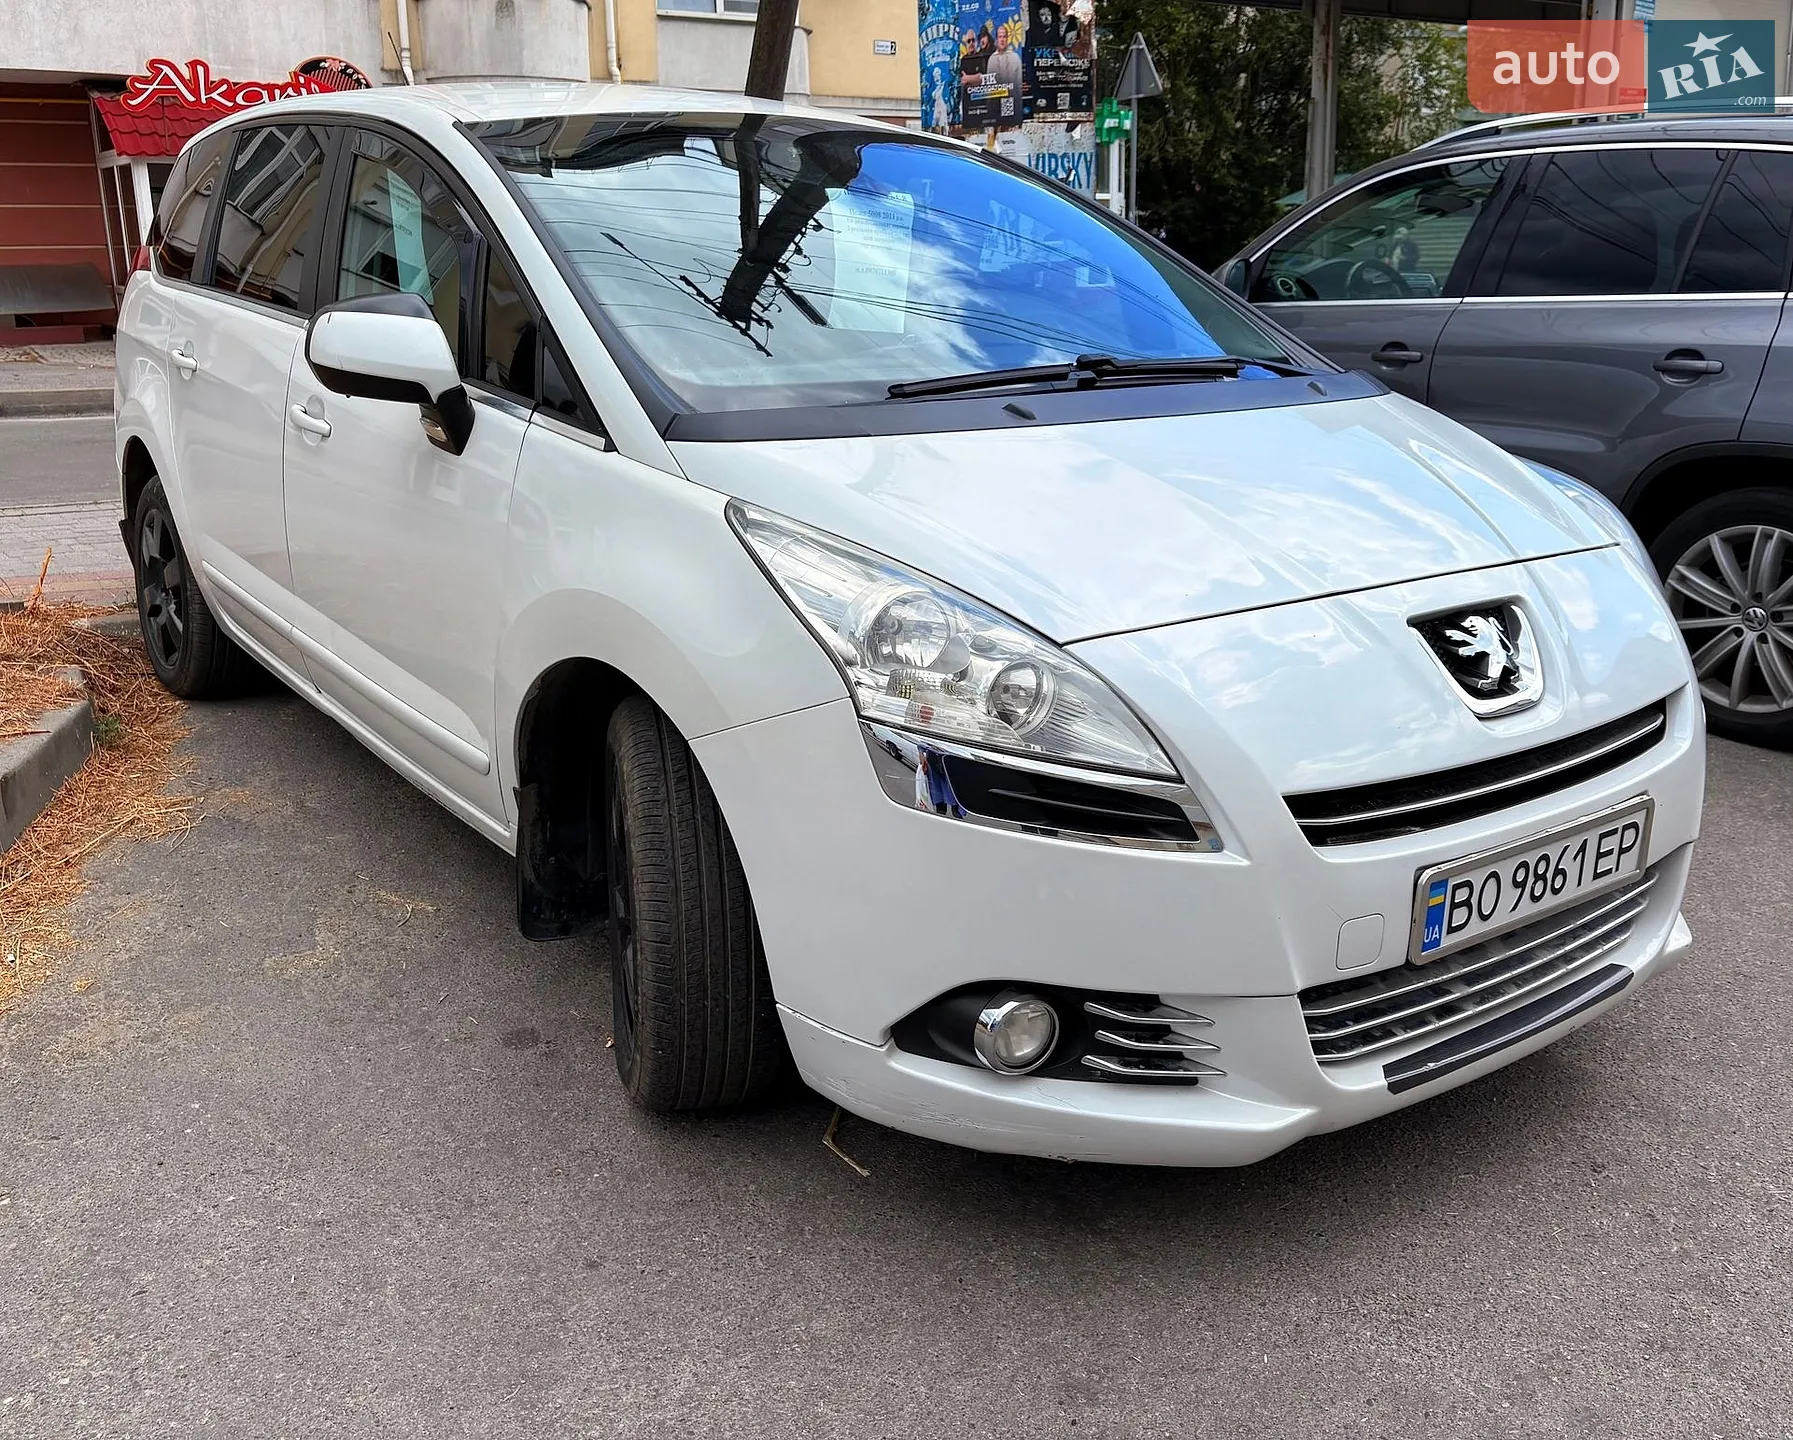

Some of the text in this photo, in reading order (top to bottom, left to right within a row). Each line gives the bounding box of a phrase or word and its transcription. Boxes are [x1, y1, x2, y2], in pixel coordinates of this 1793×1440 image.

[1034, 58, 1090, 67] ПЕРЕОЖЕ
[1446, 820, 1640, 935] BO 9861 EP
[1424, 924, 1440, 943] UA
